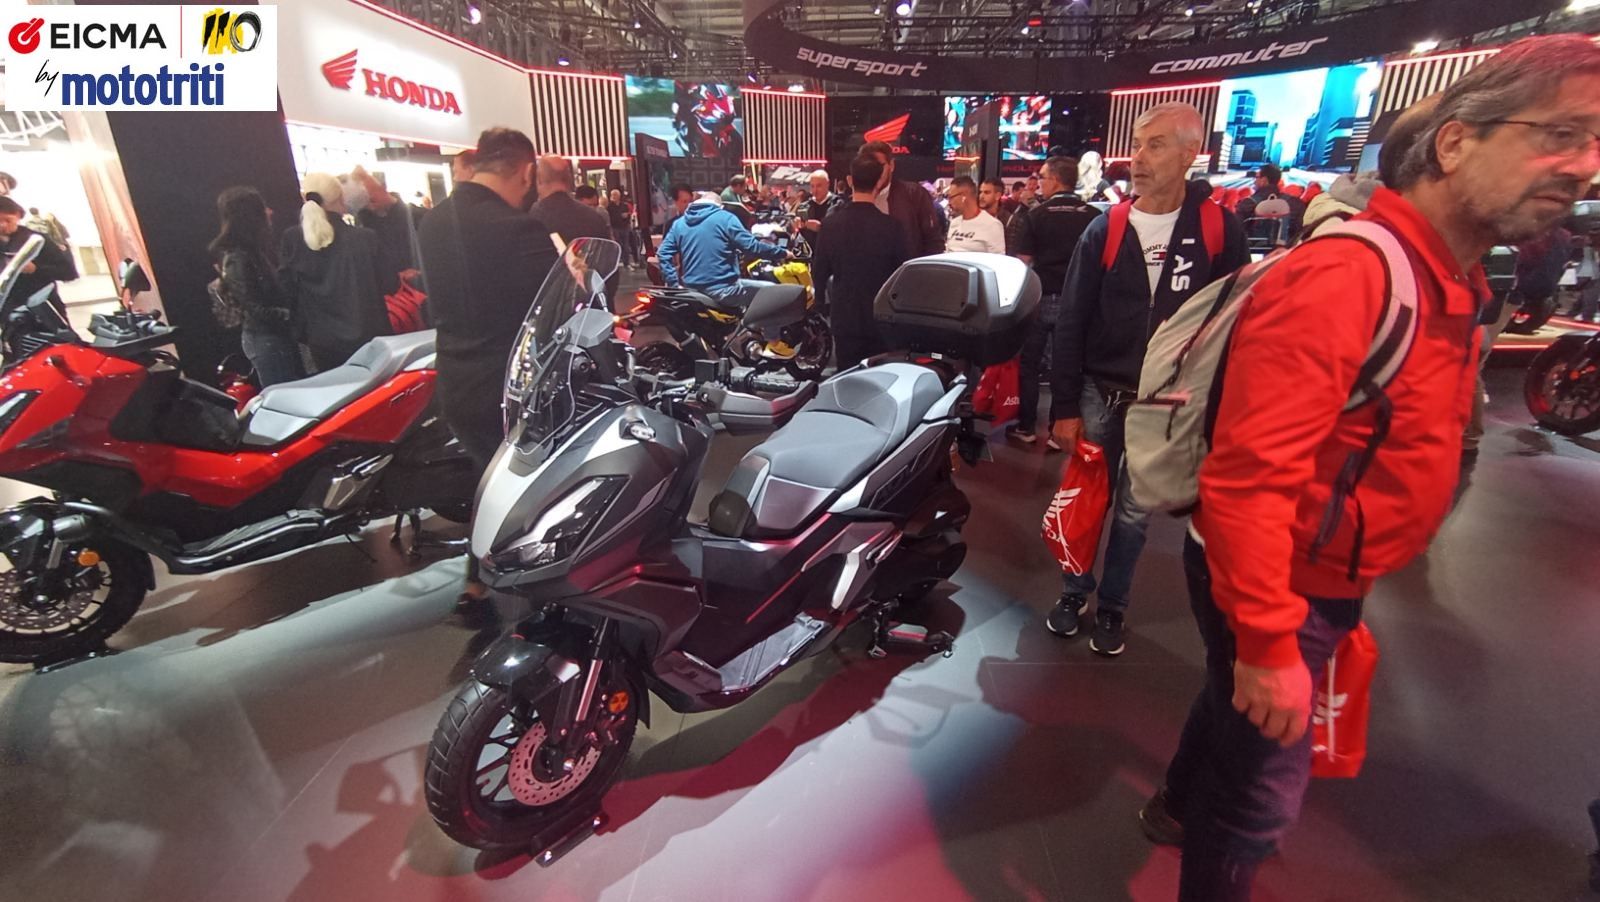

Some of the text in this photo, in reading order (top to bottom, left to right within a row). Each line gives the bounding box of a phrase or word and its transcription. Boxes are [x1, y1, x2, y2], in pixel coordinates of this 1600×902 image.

[796, 47, 928, 77] supersport
[1149, 36, 1328, 74] commuter
[362, 68, 463, 115] HONDA
